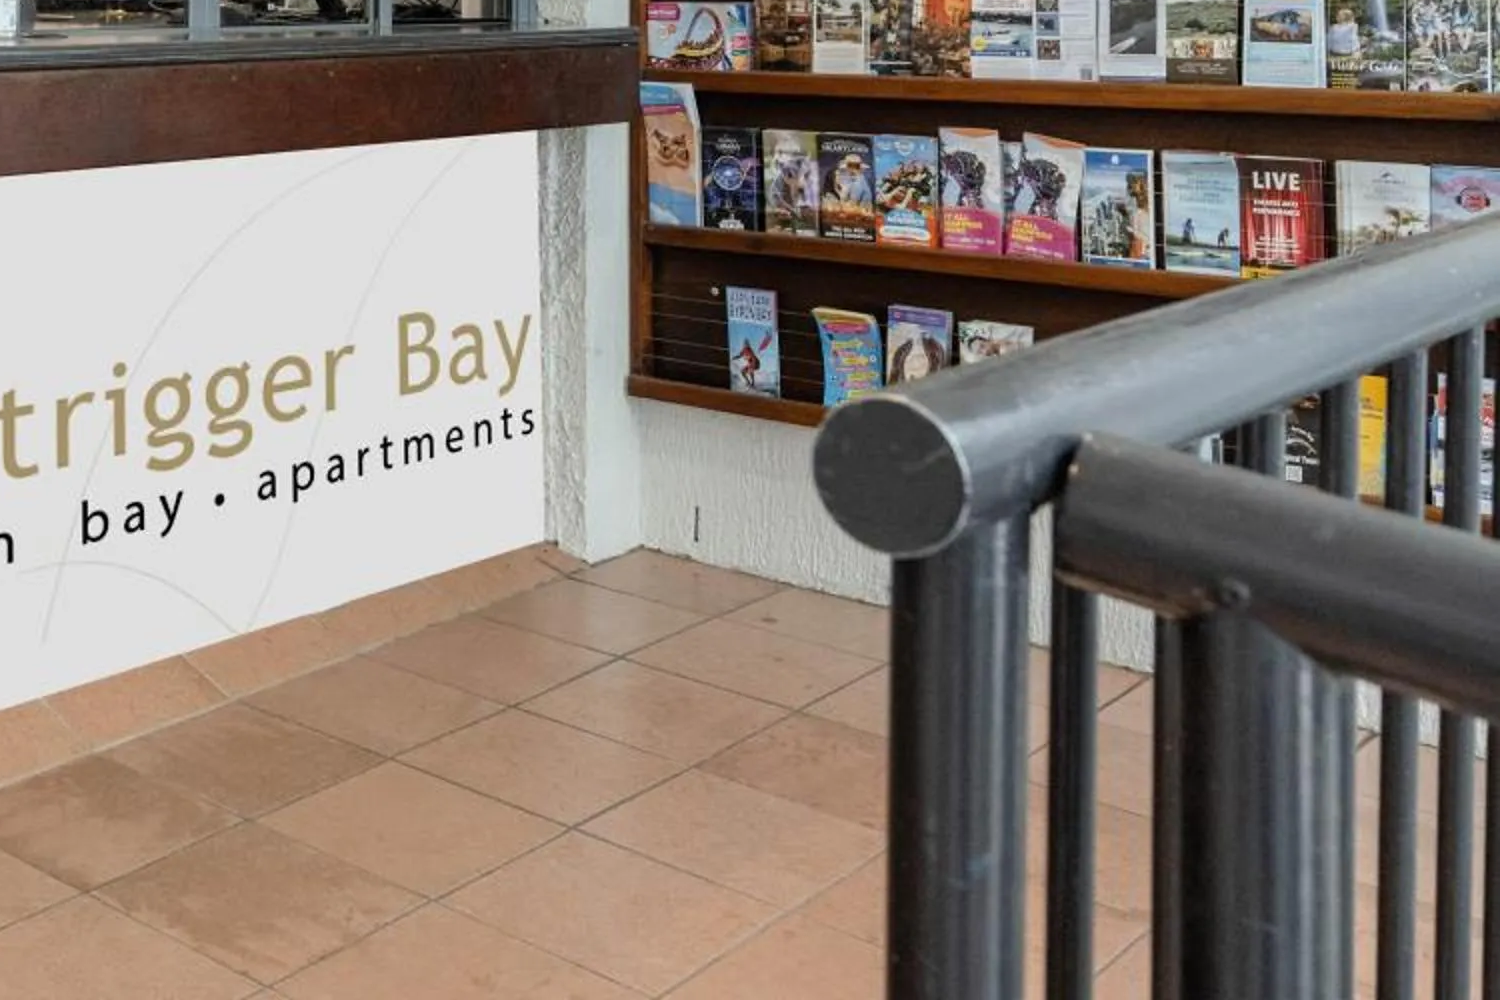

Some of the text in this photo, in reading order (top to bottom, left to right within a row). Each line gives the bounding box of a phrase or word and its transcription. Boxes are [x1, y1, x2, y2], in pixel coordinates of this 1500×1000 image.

[1252, 171, 1300, 191] LIVE
[398, 310, 532, 396] Bay
[81, 490, 185, 544] bay
[257, 405, 536, 502] apartments
